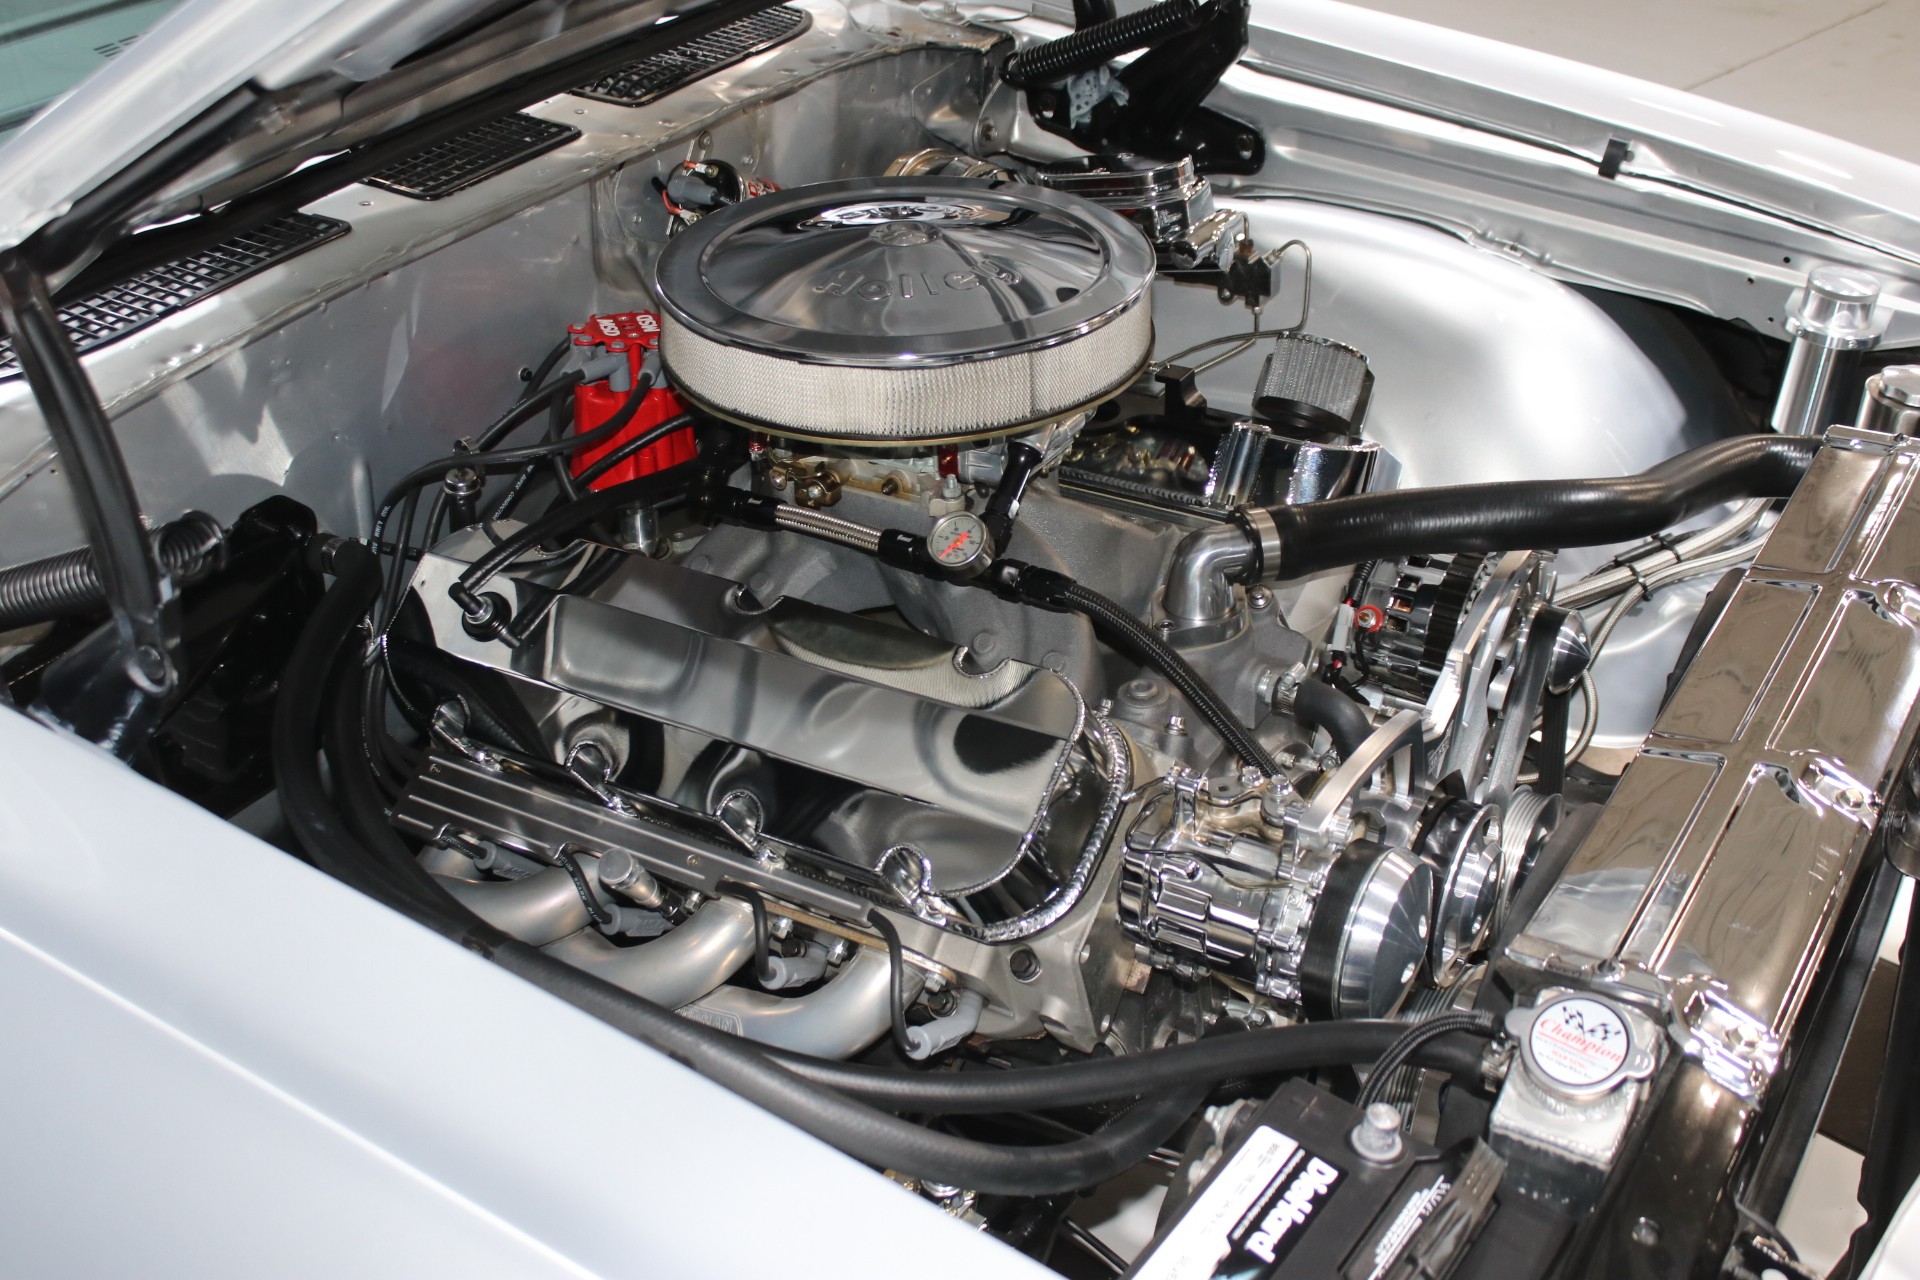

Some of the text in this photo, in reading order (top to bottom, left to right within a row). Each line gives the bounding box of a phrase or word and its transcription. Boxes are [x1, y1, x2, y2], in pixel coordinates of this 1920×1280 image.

[812, 260, 1022, 301] Holley
[597, 318, 621, 337] MSD
[636, 314, 661, 333] MSD
[1540, 1018, 1622, 1062] Champion
[1244, 1156, 1339, 1264] DieHard
